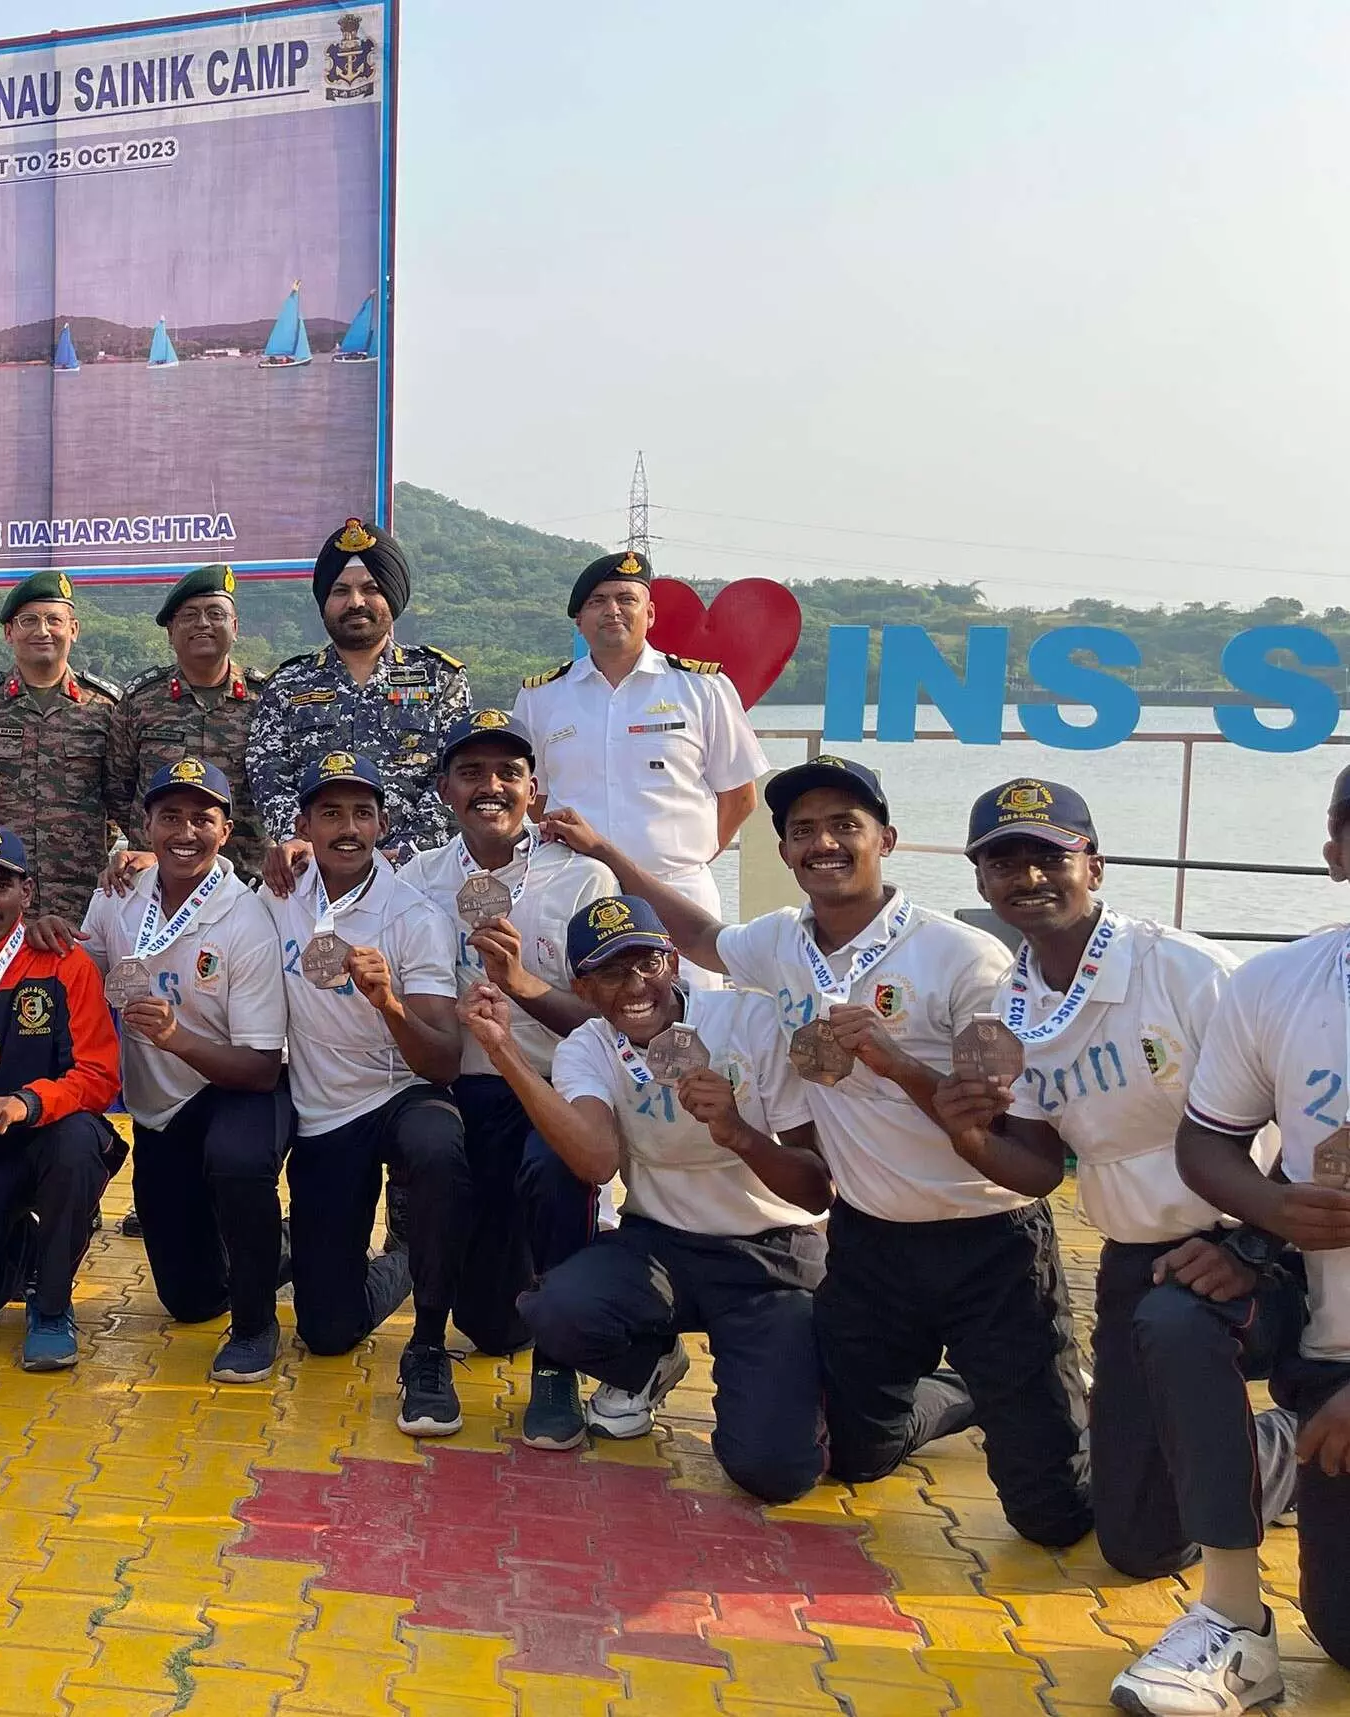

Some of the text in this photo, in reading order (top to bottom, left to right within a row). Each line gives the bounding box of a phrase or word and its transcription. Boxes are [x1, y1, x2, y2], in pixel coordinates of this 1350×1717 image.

[73, 53, 195, 112] SAINIK
[206, 39, 309, 97] CAMP
[15, 152, 41, 173] TO
[48, 149, 71, 170] 25
[78, 144, 120, 167] OCT
[127, 139, 177, 161] 2023
[8, 514, 235, 546] MAHARASHTRA
[822, 623, 1142, 752] INS
[144, 903, 158, 930] 2023
[169, 908, 191, 936] AINSC
[1088, 918, 1116, 959] 2023
[857, 943, 887, 969] 2023
[1051, 983, 1086, 1025] AINSC
